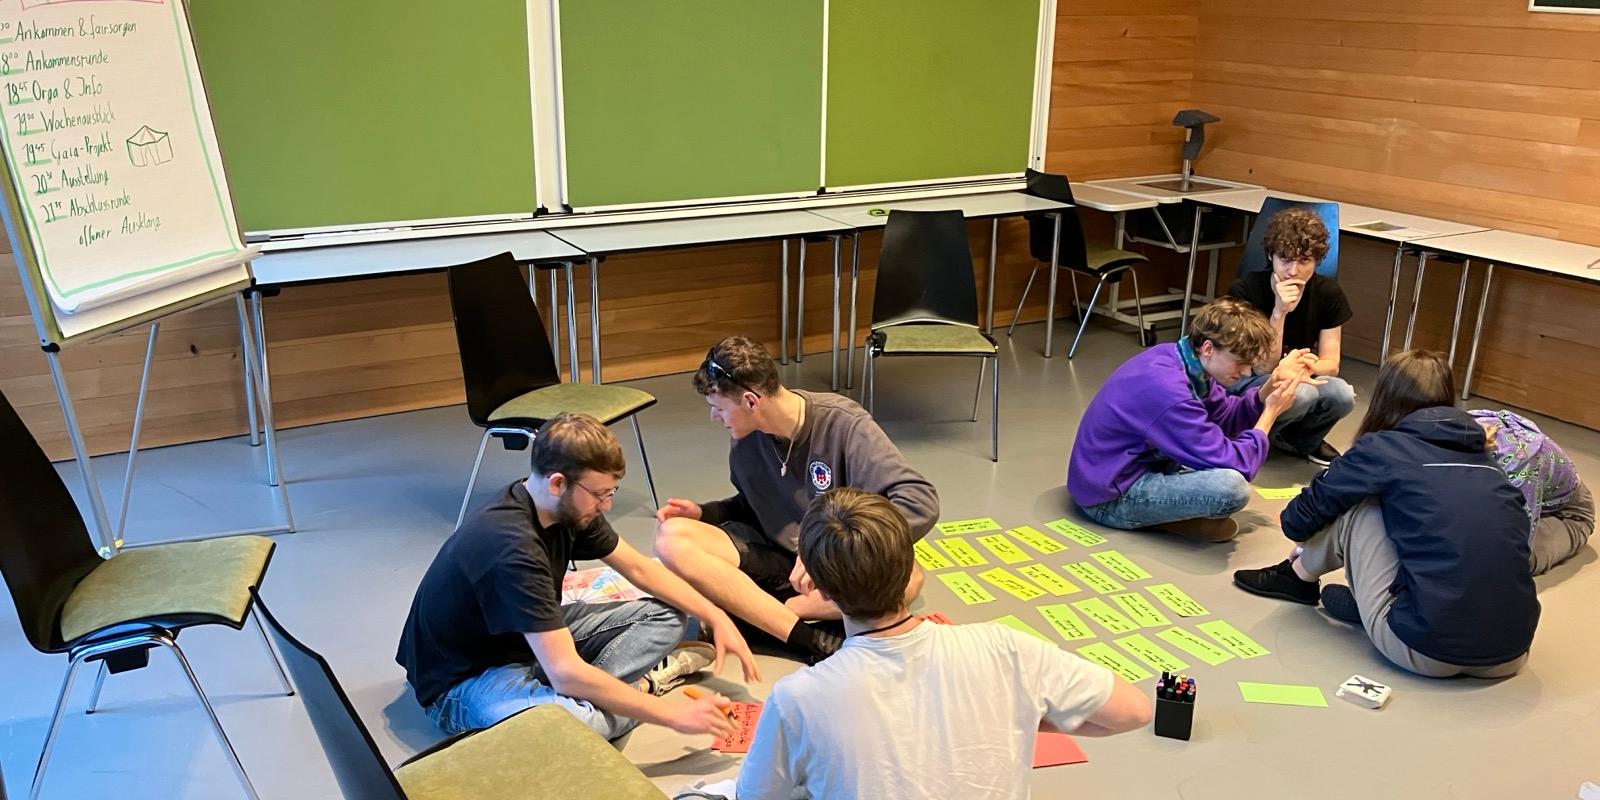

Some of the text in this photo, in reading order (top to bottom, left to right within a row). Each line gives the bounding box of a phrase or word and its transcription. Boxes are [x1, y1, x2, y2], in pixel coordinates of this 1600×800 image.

[15, 20, 75, 41] Ankommen
[79, 17, 88, 37] &
[26, 48, 109, 72] Ankommensrunde
[32, 80, 59, 104] Orga
[63, 78, 74, 100] &
[61, 163, 109, 188] Ausstellung
[70, 188, 131, 216] Abschlussrunde
